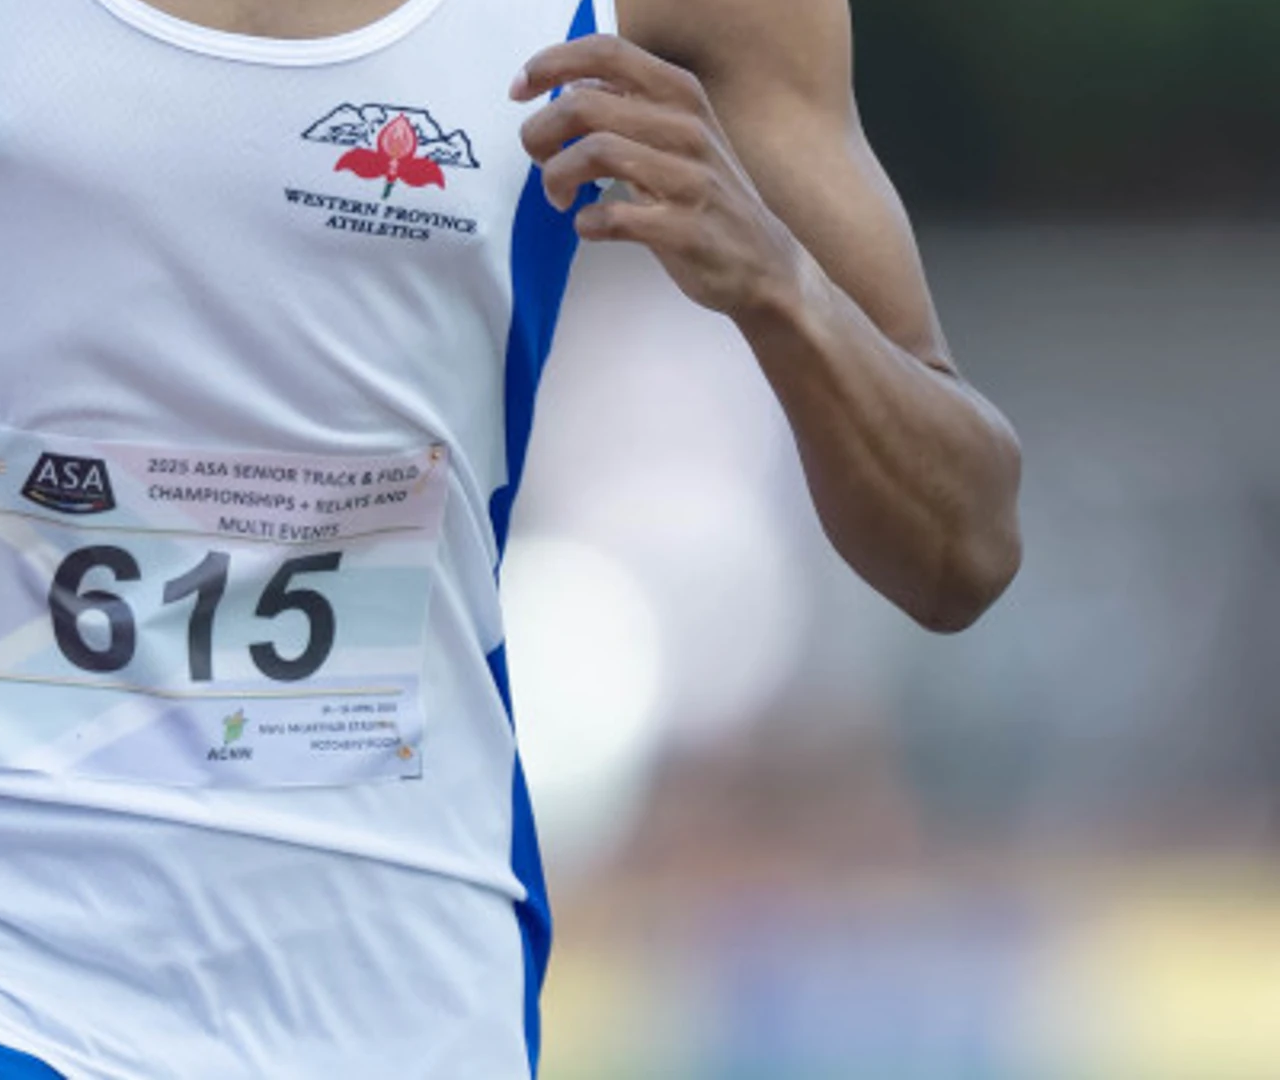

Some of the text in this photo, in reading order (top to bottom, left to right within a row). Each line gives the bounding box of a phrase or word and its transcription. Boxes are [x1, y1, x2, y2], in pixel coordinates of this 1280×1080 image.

[285, 188, 478, 235] WESTERN PROVINCE
[326, 216, 431, 240] ATHLETICS
[37, 458, 104, 492] ASA
[147, 458, 420, 486] 2025 ASA SENIOR TRACK & FIELD
[148, 484, 295, 511] CHAMPIONSHIPS
[315, 494, 371, 514] RELAYS
[374, 490, 408, 505] AND
[218, 516, 339, 540] MULTI EVENTS
[47, 544, 344, 682] 615
